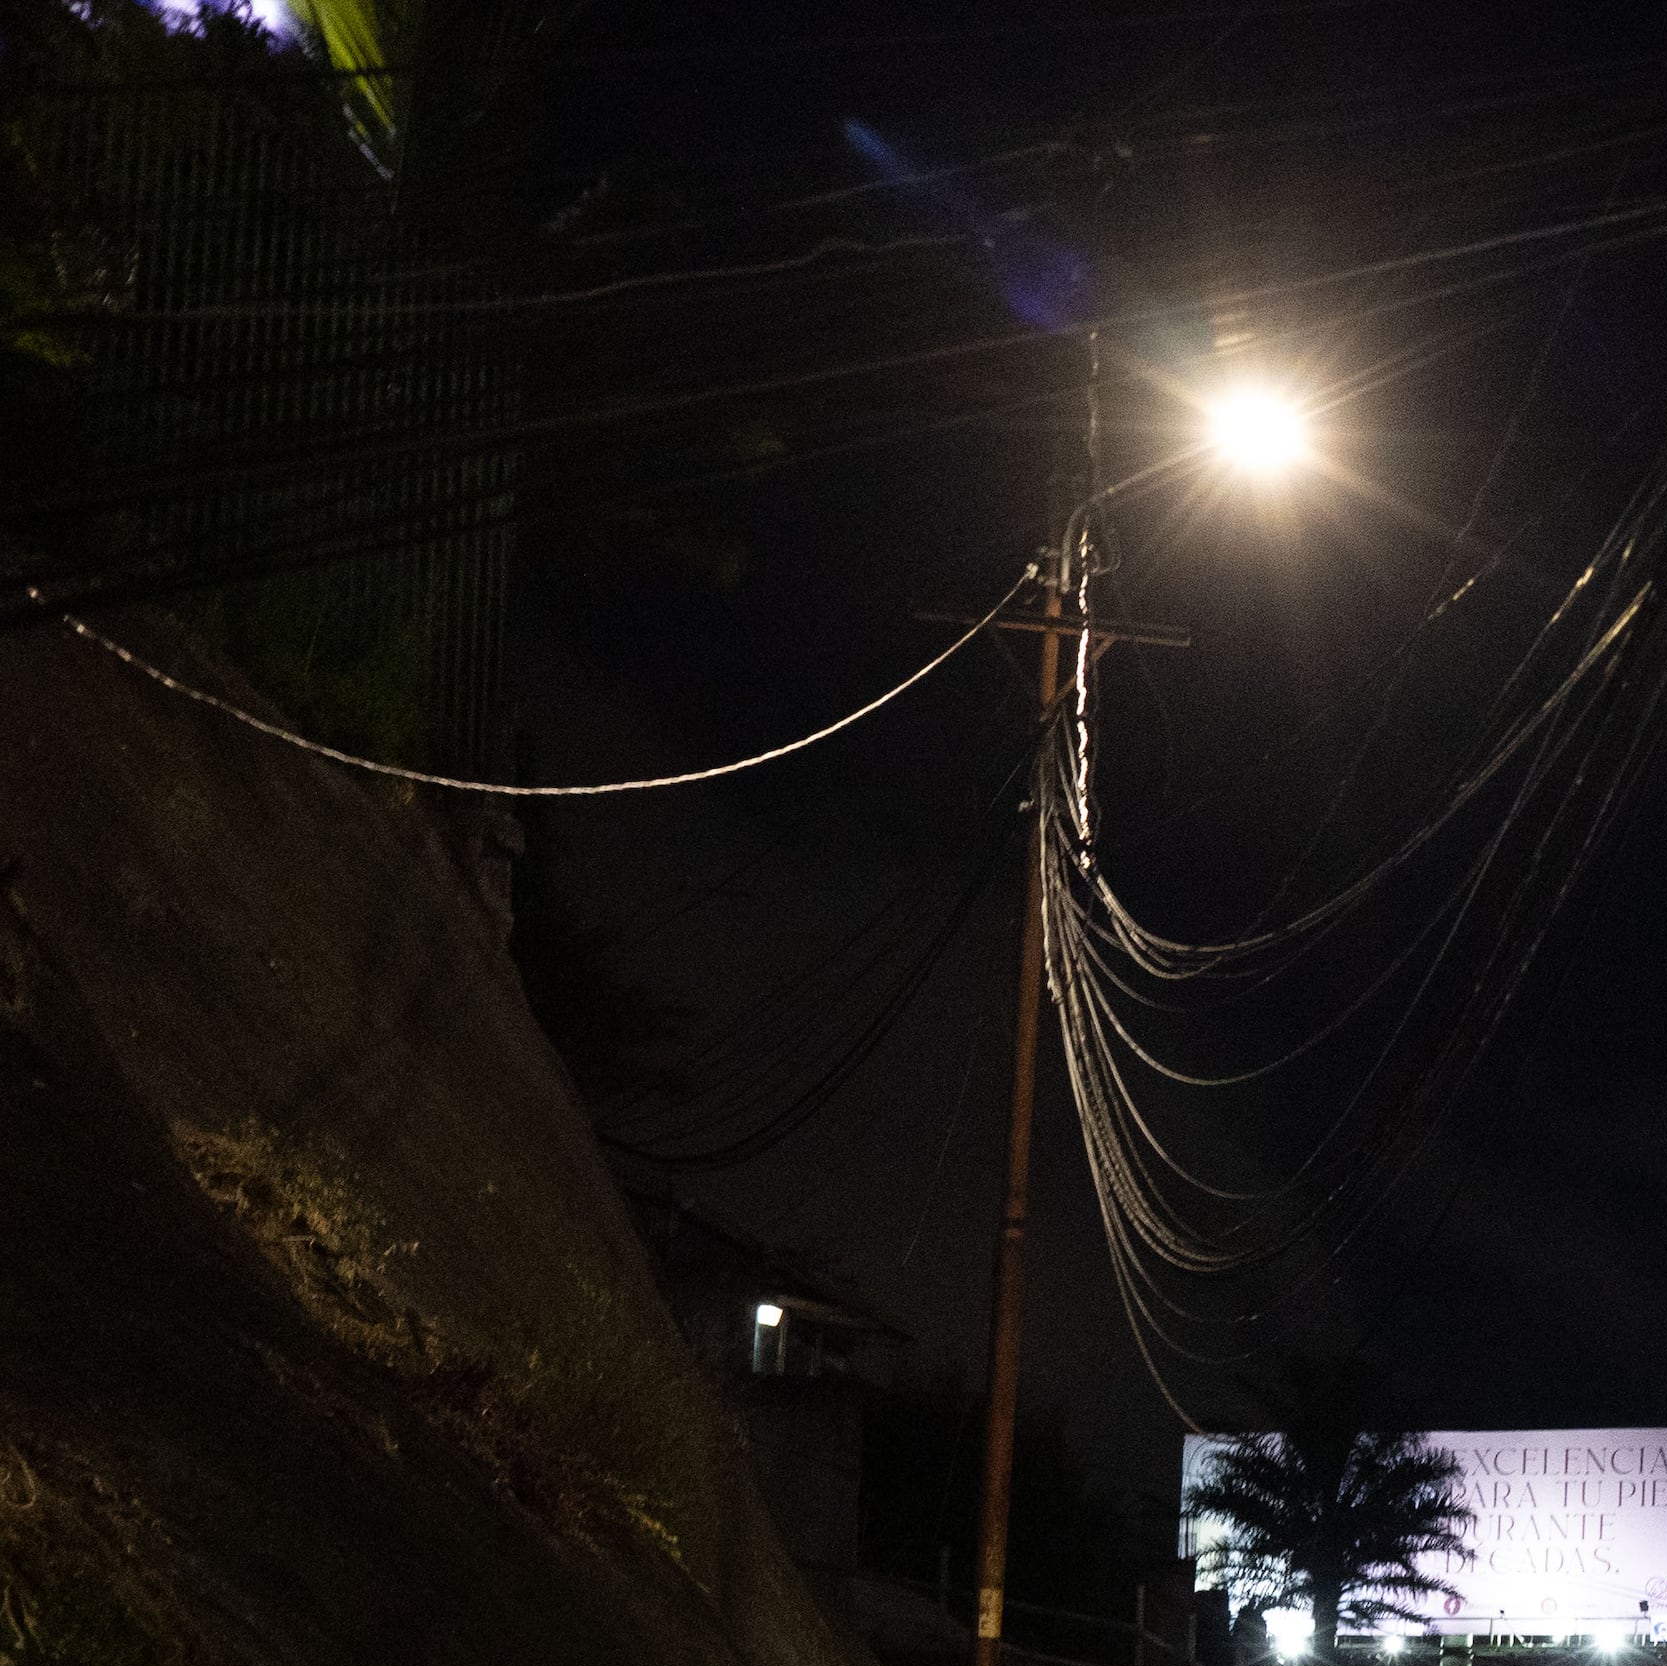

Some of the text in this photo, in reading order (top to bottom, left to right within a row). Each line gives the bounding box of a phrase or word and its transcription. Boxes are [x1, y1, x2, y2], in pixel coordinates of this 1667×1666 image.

[1449, 1479, 1537, 1509] PARA
[1555, 1479, 1602, 1508] TU
[1446, 1513, 1617, 1542] DURANTE
